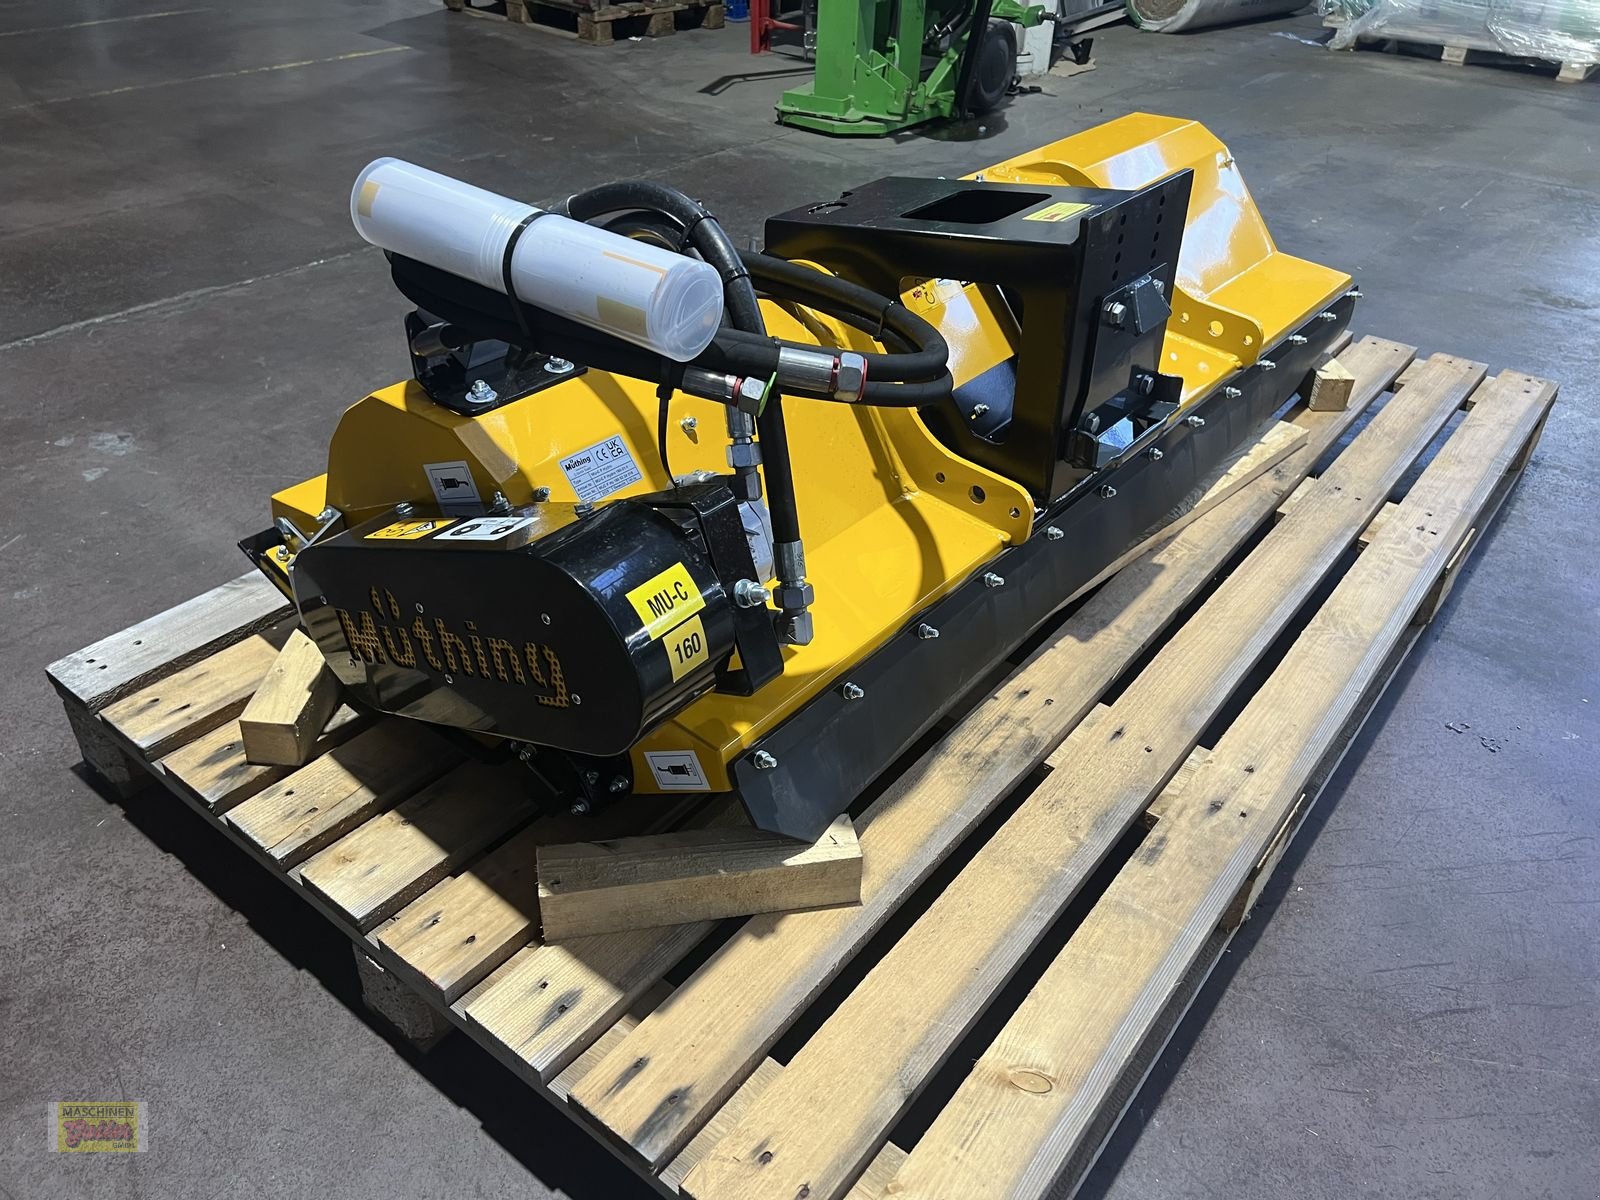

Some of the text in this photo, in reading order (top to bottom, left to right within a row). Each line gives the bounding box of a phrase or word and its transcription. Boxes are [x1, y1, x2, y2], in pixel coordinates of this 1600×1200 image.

[606, 440, 619, 450] UK
[610, 448, 624, 458] CA
[564, 456, 592, 472] Müthing
[646, 581, 689, 619] MU-C
[336, 586, 569, 708] Müthing
[674, 631, 702, 664] 160
